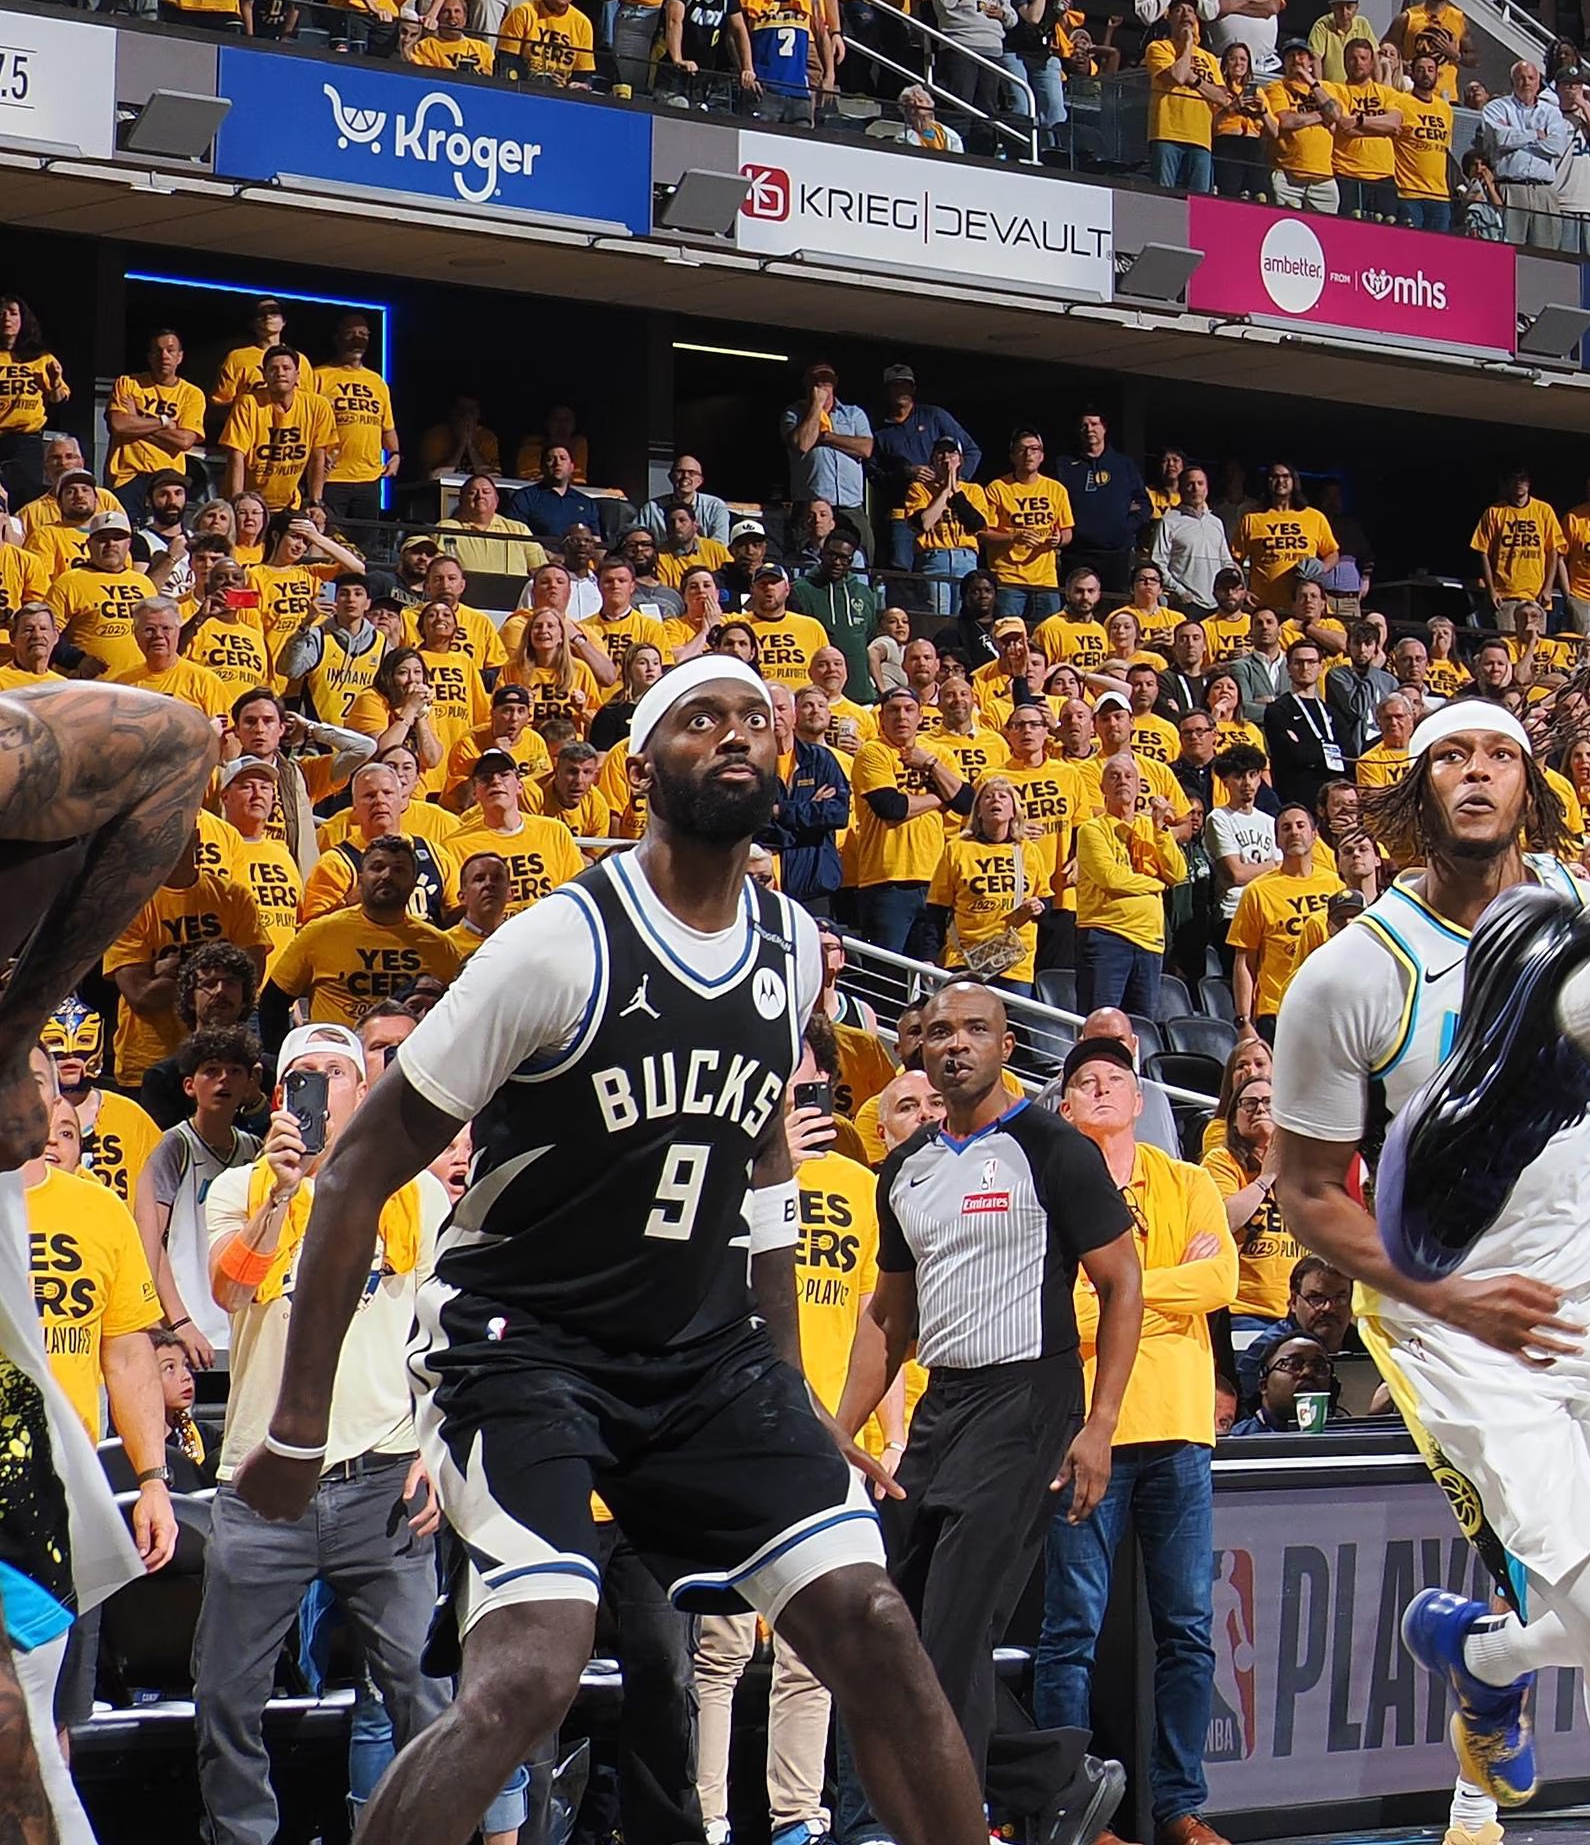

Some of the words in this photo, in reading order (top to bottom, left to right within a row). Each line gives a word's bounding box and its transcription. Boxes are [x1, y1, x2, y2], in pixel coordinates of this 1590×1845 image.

[395, 92, 542, 203] Kroger
[800, 185, 918, 229] KRIEG
[936, 205, 1112, 261] DEVAULT
[1330, 272, 1350, 284] FROM
[1394, 270, 1446, 309] mhs
[1021, 797, 1068, 817] ERS
[250, 885, 297, 906] ERS
[161, 913, 222, 937] YES
[356, 948, 421, 970] YES
[592, 1050, 780, 1139] BUCKS
[645, 1144, 711, 1240] 9
[798, 1192, 852, 1226] ES
[962, 1195, 1009, 1211] Emirates
[29, 1234, 81, 1270] ES
[798, 1231, 860, 1272] ERS
[1203, 1718, 1234, 1752] NBA
